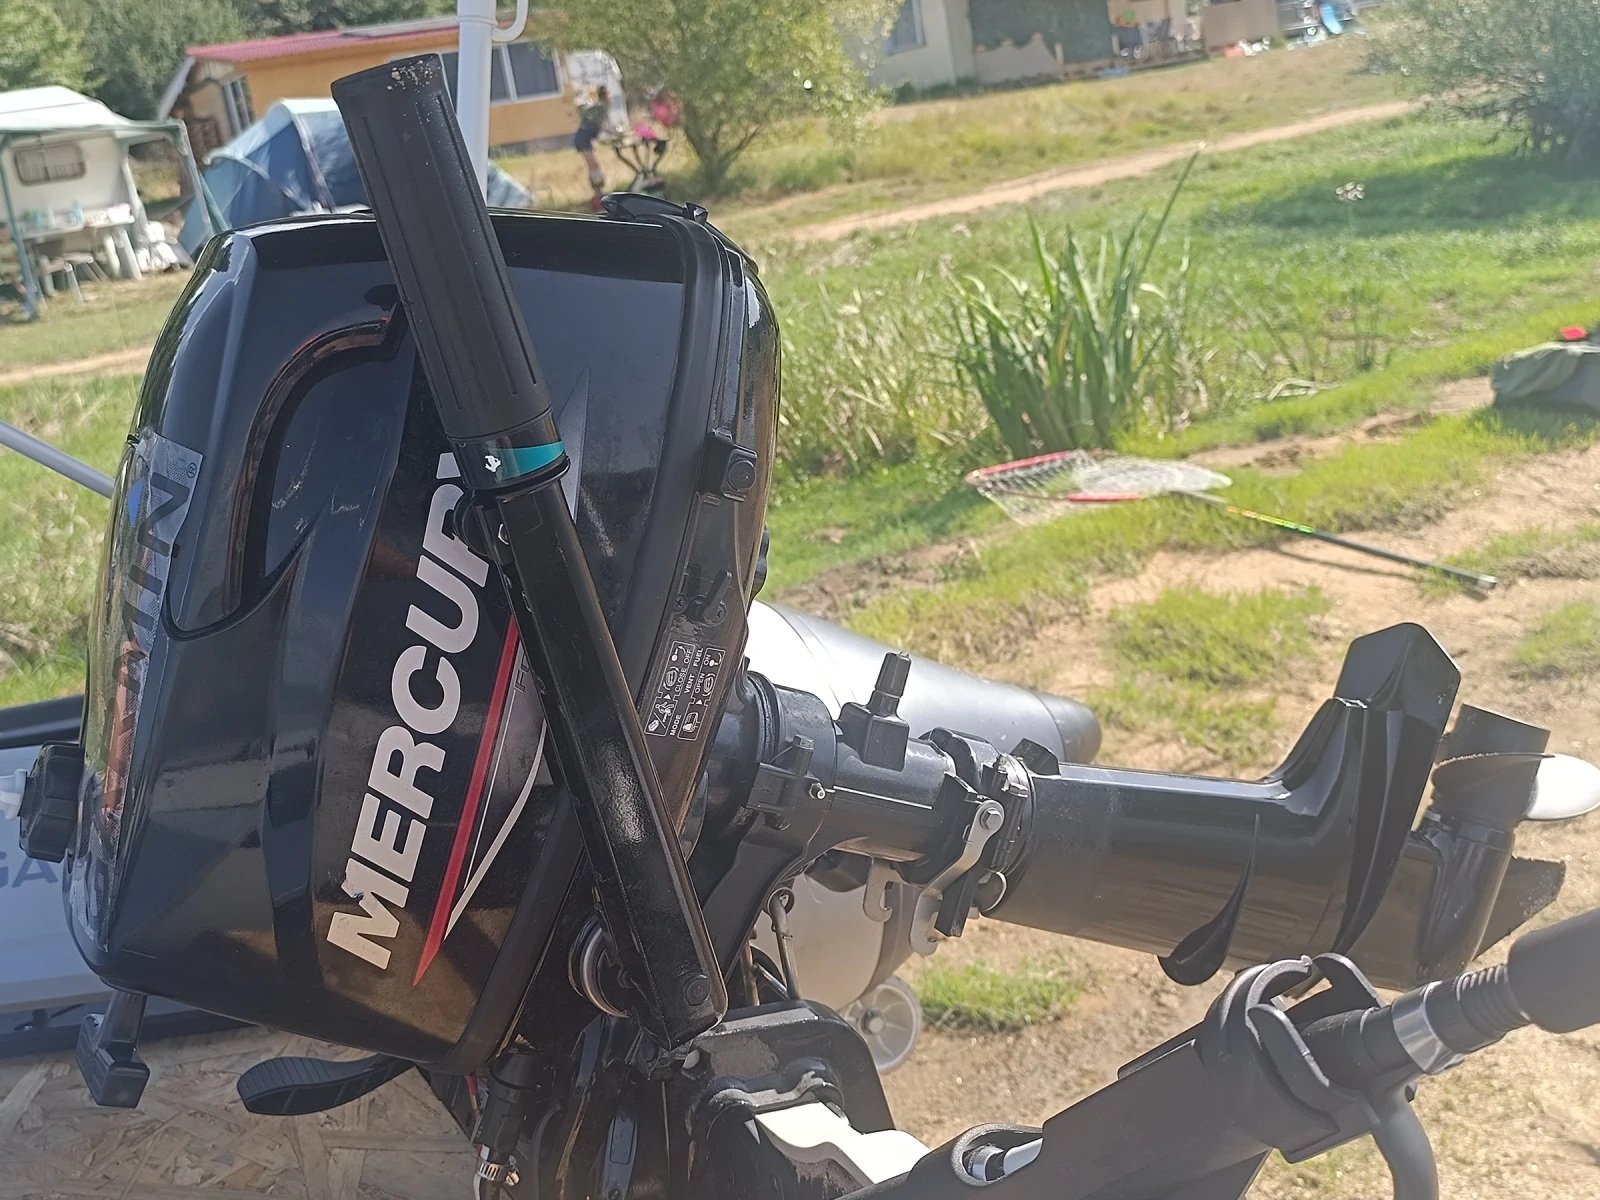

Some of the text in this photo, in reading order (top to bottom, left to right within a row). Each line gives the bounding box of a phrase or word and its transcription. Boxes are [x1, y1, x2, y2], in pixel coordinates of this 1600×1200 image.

[683, 648, 692, 664] OFF
[693, 648, 703, 667] FUEL
[703, 654, 711, 666] ON
[675, 667, 688, 692] CLOSE
[684, 674, 695, 694] VENT
[695, 673, 705, 694] OPEN
[327, 452, 489, 970] MERCUR
[670, 714, 682, 736] MODE
